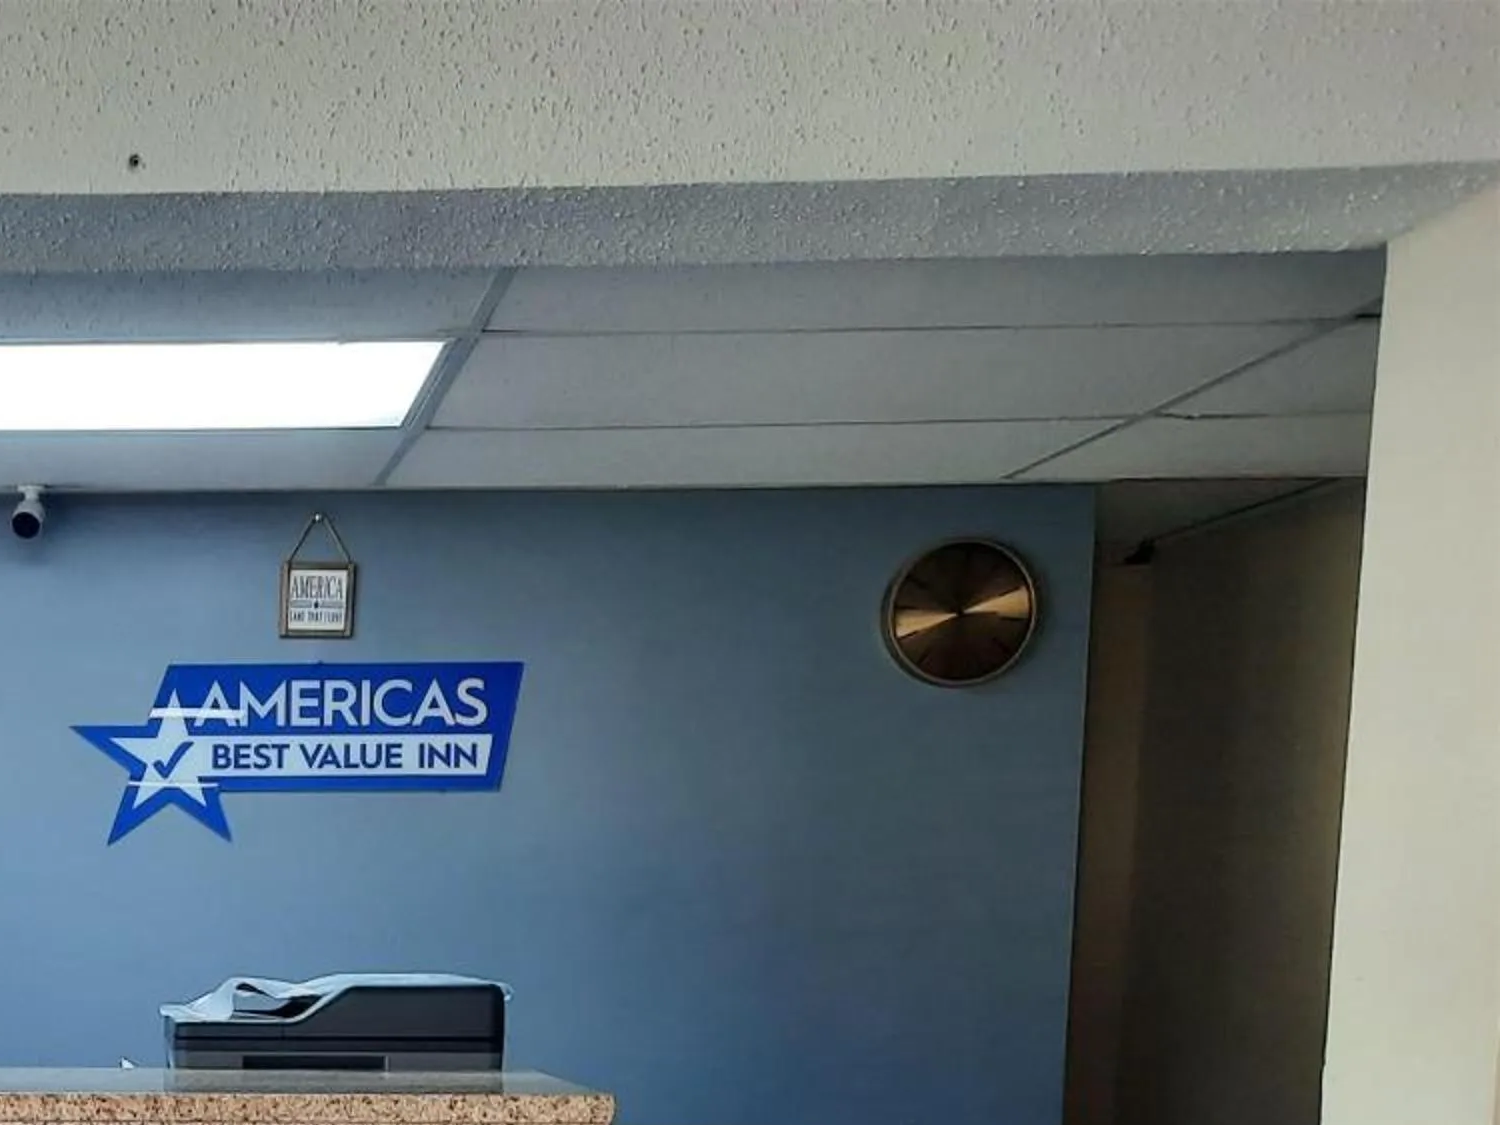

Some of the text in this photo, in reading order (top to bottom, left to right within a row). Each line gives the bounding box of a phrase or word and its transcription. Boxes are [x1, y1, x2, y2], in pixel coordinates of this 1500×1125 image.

[291, 575, 343, 599] AMERICA
[194, 677, 489, 728] AMERICAS
[211, 743, 478, 769] BEST VALUE INN
